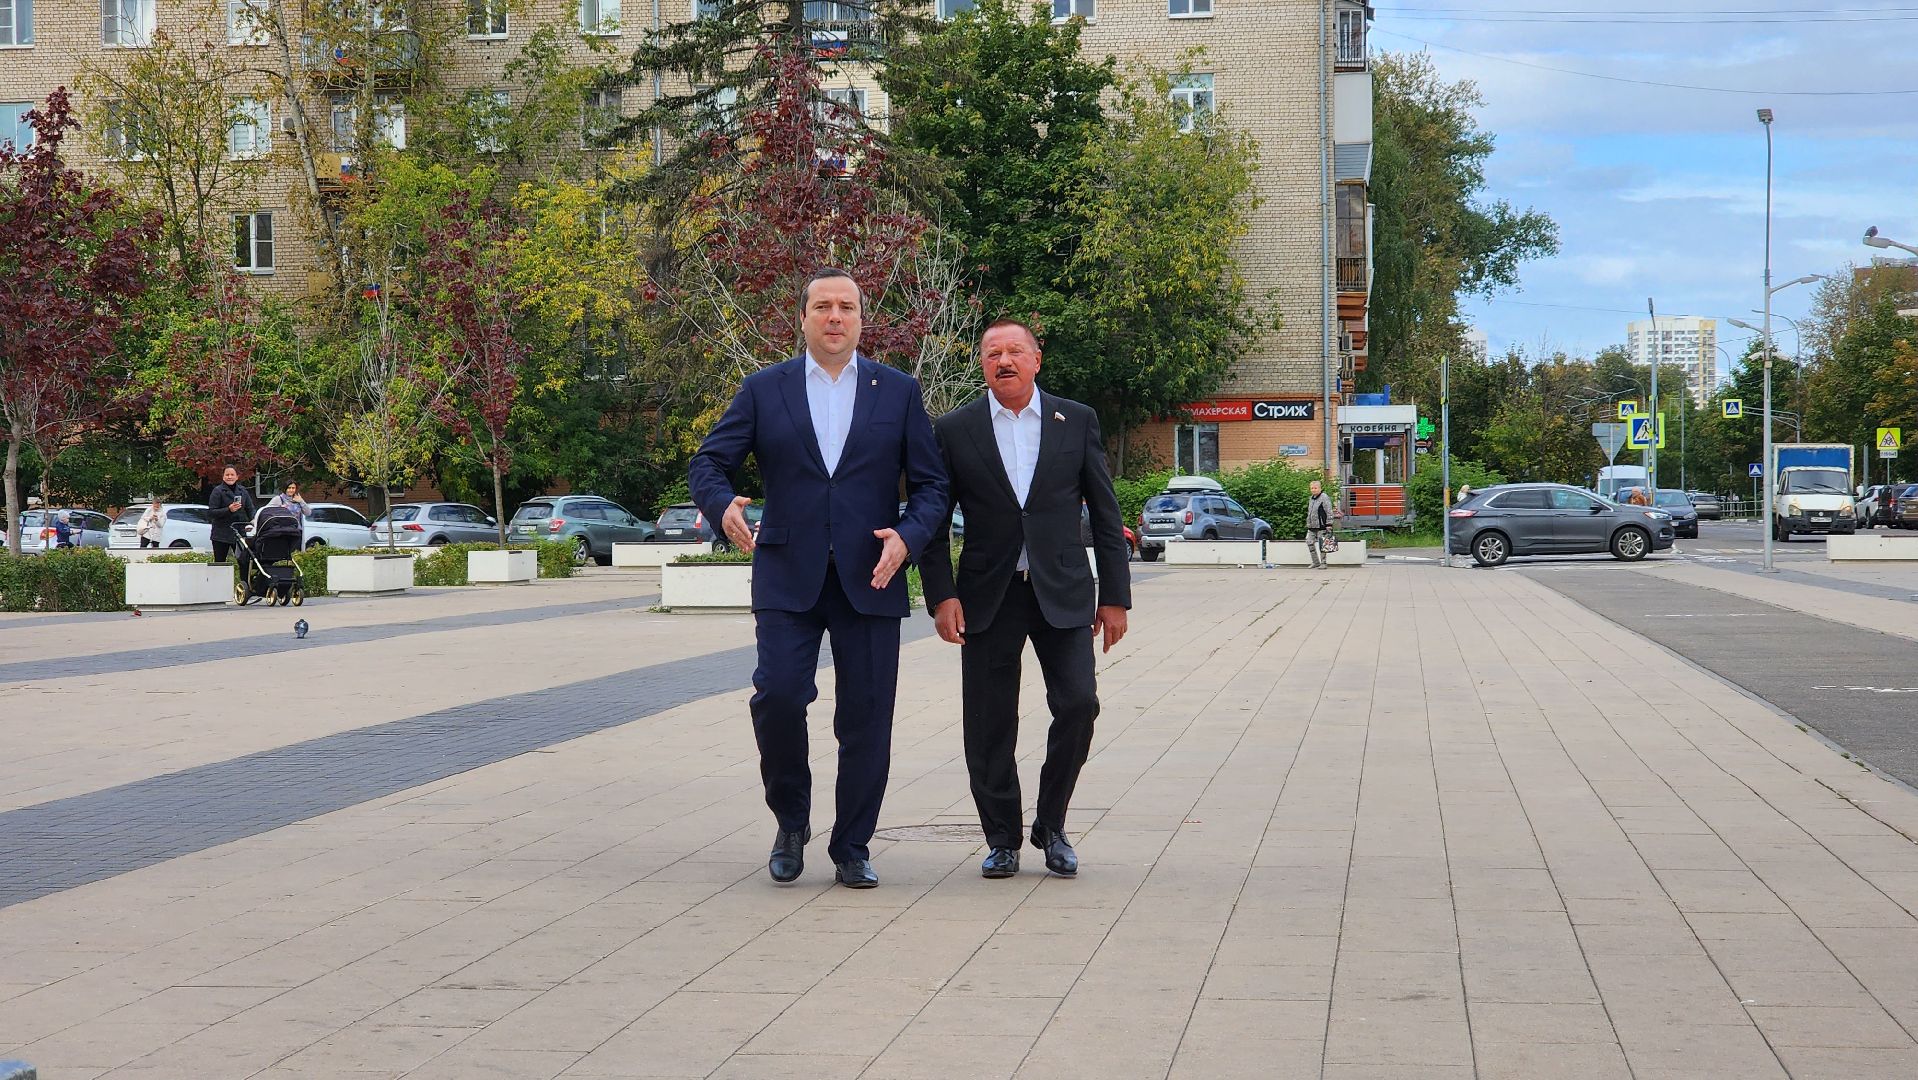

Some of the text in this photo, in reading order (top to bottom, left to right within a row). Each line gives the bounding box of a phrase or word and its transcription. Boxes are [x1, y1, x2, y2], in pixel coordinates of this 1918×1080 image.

[1181, 406, 1247, 416] МАХЕРСКАЯ
[1254, 402, 1308, 418] Стриж
[1350, 424, 1397, 432] КОФЕЙНЯ
